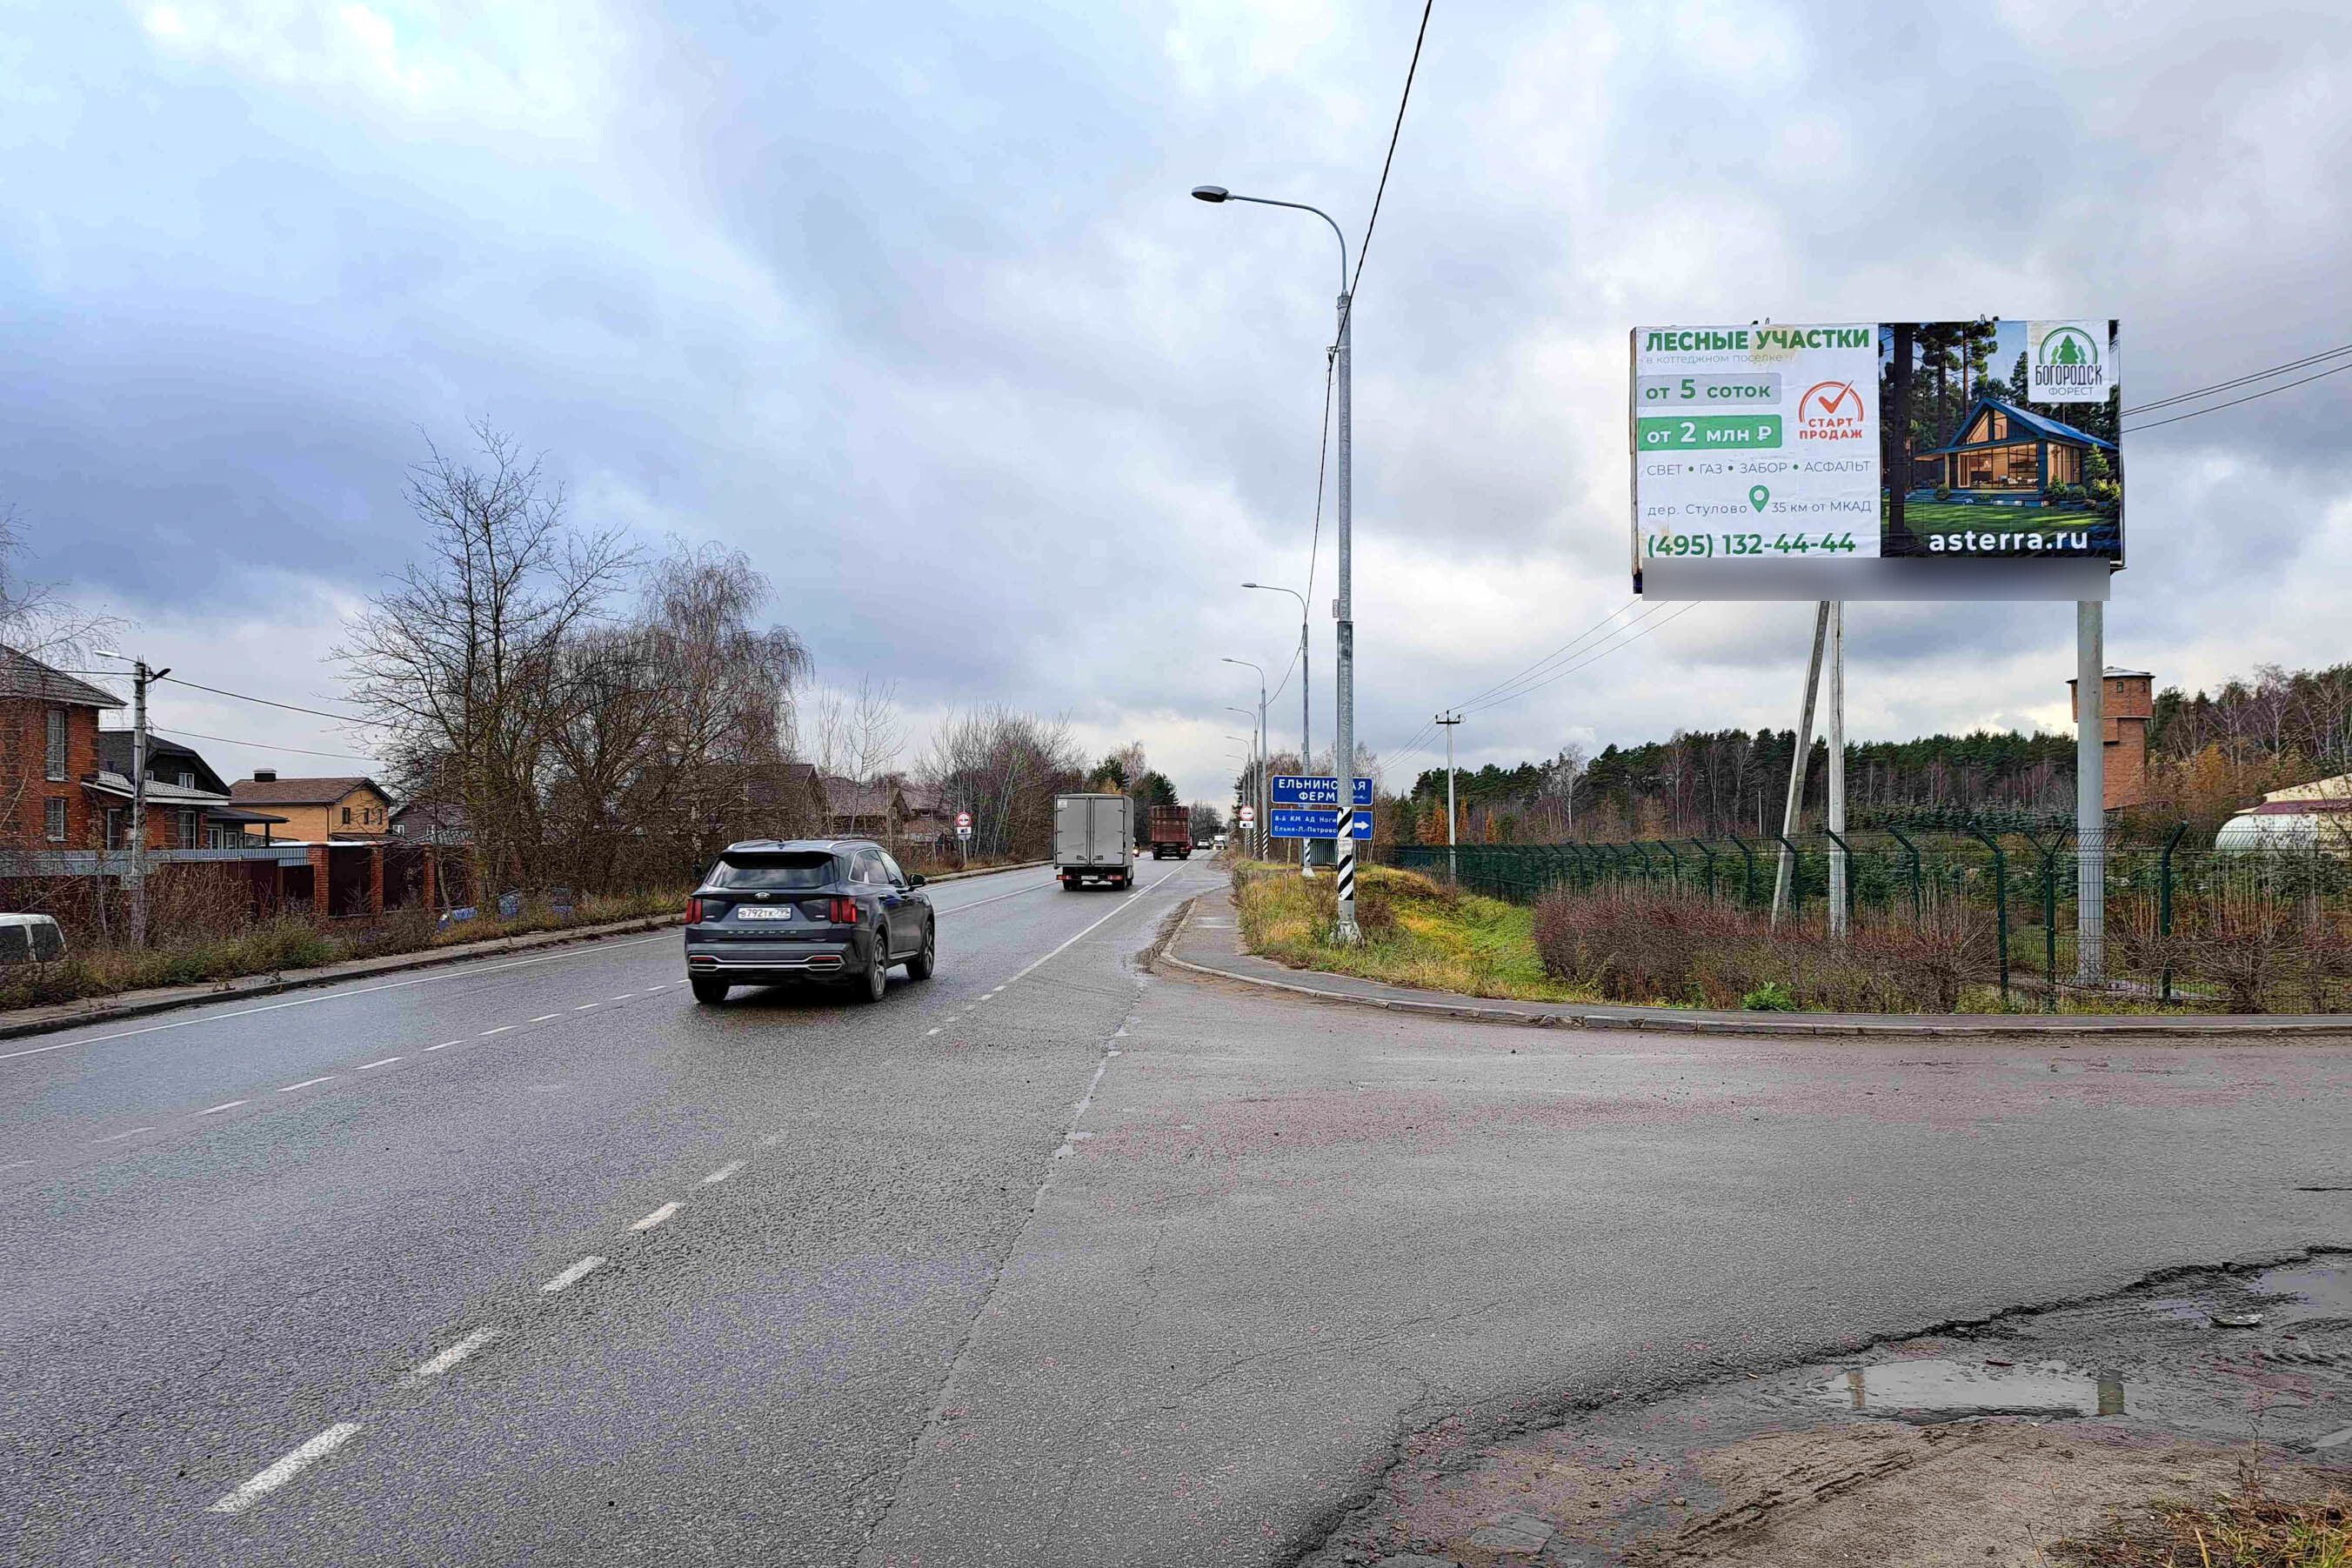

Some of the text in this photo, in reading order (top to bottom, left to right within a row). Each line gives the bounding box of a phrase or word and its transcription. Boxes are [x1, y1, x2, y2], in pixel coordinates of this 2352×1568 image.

[1646, 328, 1870, 352] ЛЕСНЫЕ УЧАСТКИ
[1656, 354, 1729, 364] коттеджном
[1733, 352, 1782, 363] поселке
[2035, 364, 2102, 385] БОГОРОДСК
[1646, 378, 1772, 399] от 5 соток
[2048, 386, 2095, 396] ФОРЕСТ
[1808, 417, 1854, 428] СТАРТ
[1647, 430, 1671, 443] от
[1680, 421, 1696, 443] 2
[1707, 428, 1750, 442] млн
[1799, 430, 1863, 441] ПРОДАЖ
[1647, 460, 1871, 476] СВЕТ ГАЗ ЗАБОР АСФАЛЬТ
[1647, 500, 1872, 517] дер. Стулово 35 км от МКАД
[1647, 532, 1856, 557] (495) 132-44-44
[1928, 529, 2088, 551] asterra.ru
[1278, 778, 1366, 791] ЕЛЬНИНСЯ
[1298, 791, 1336, 802] ФЕРМ
